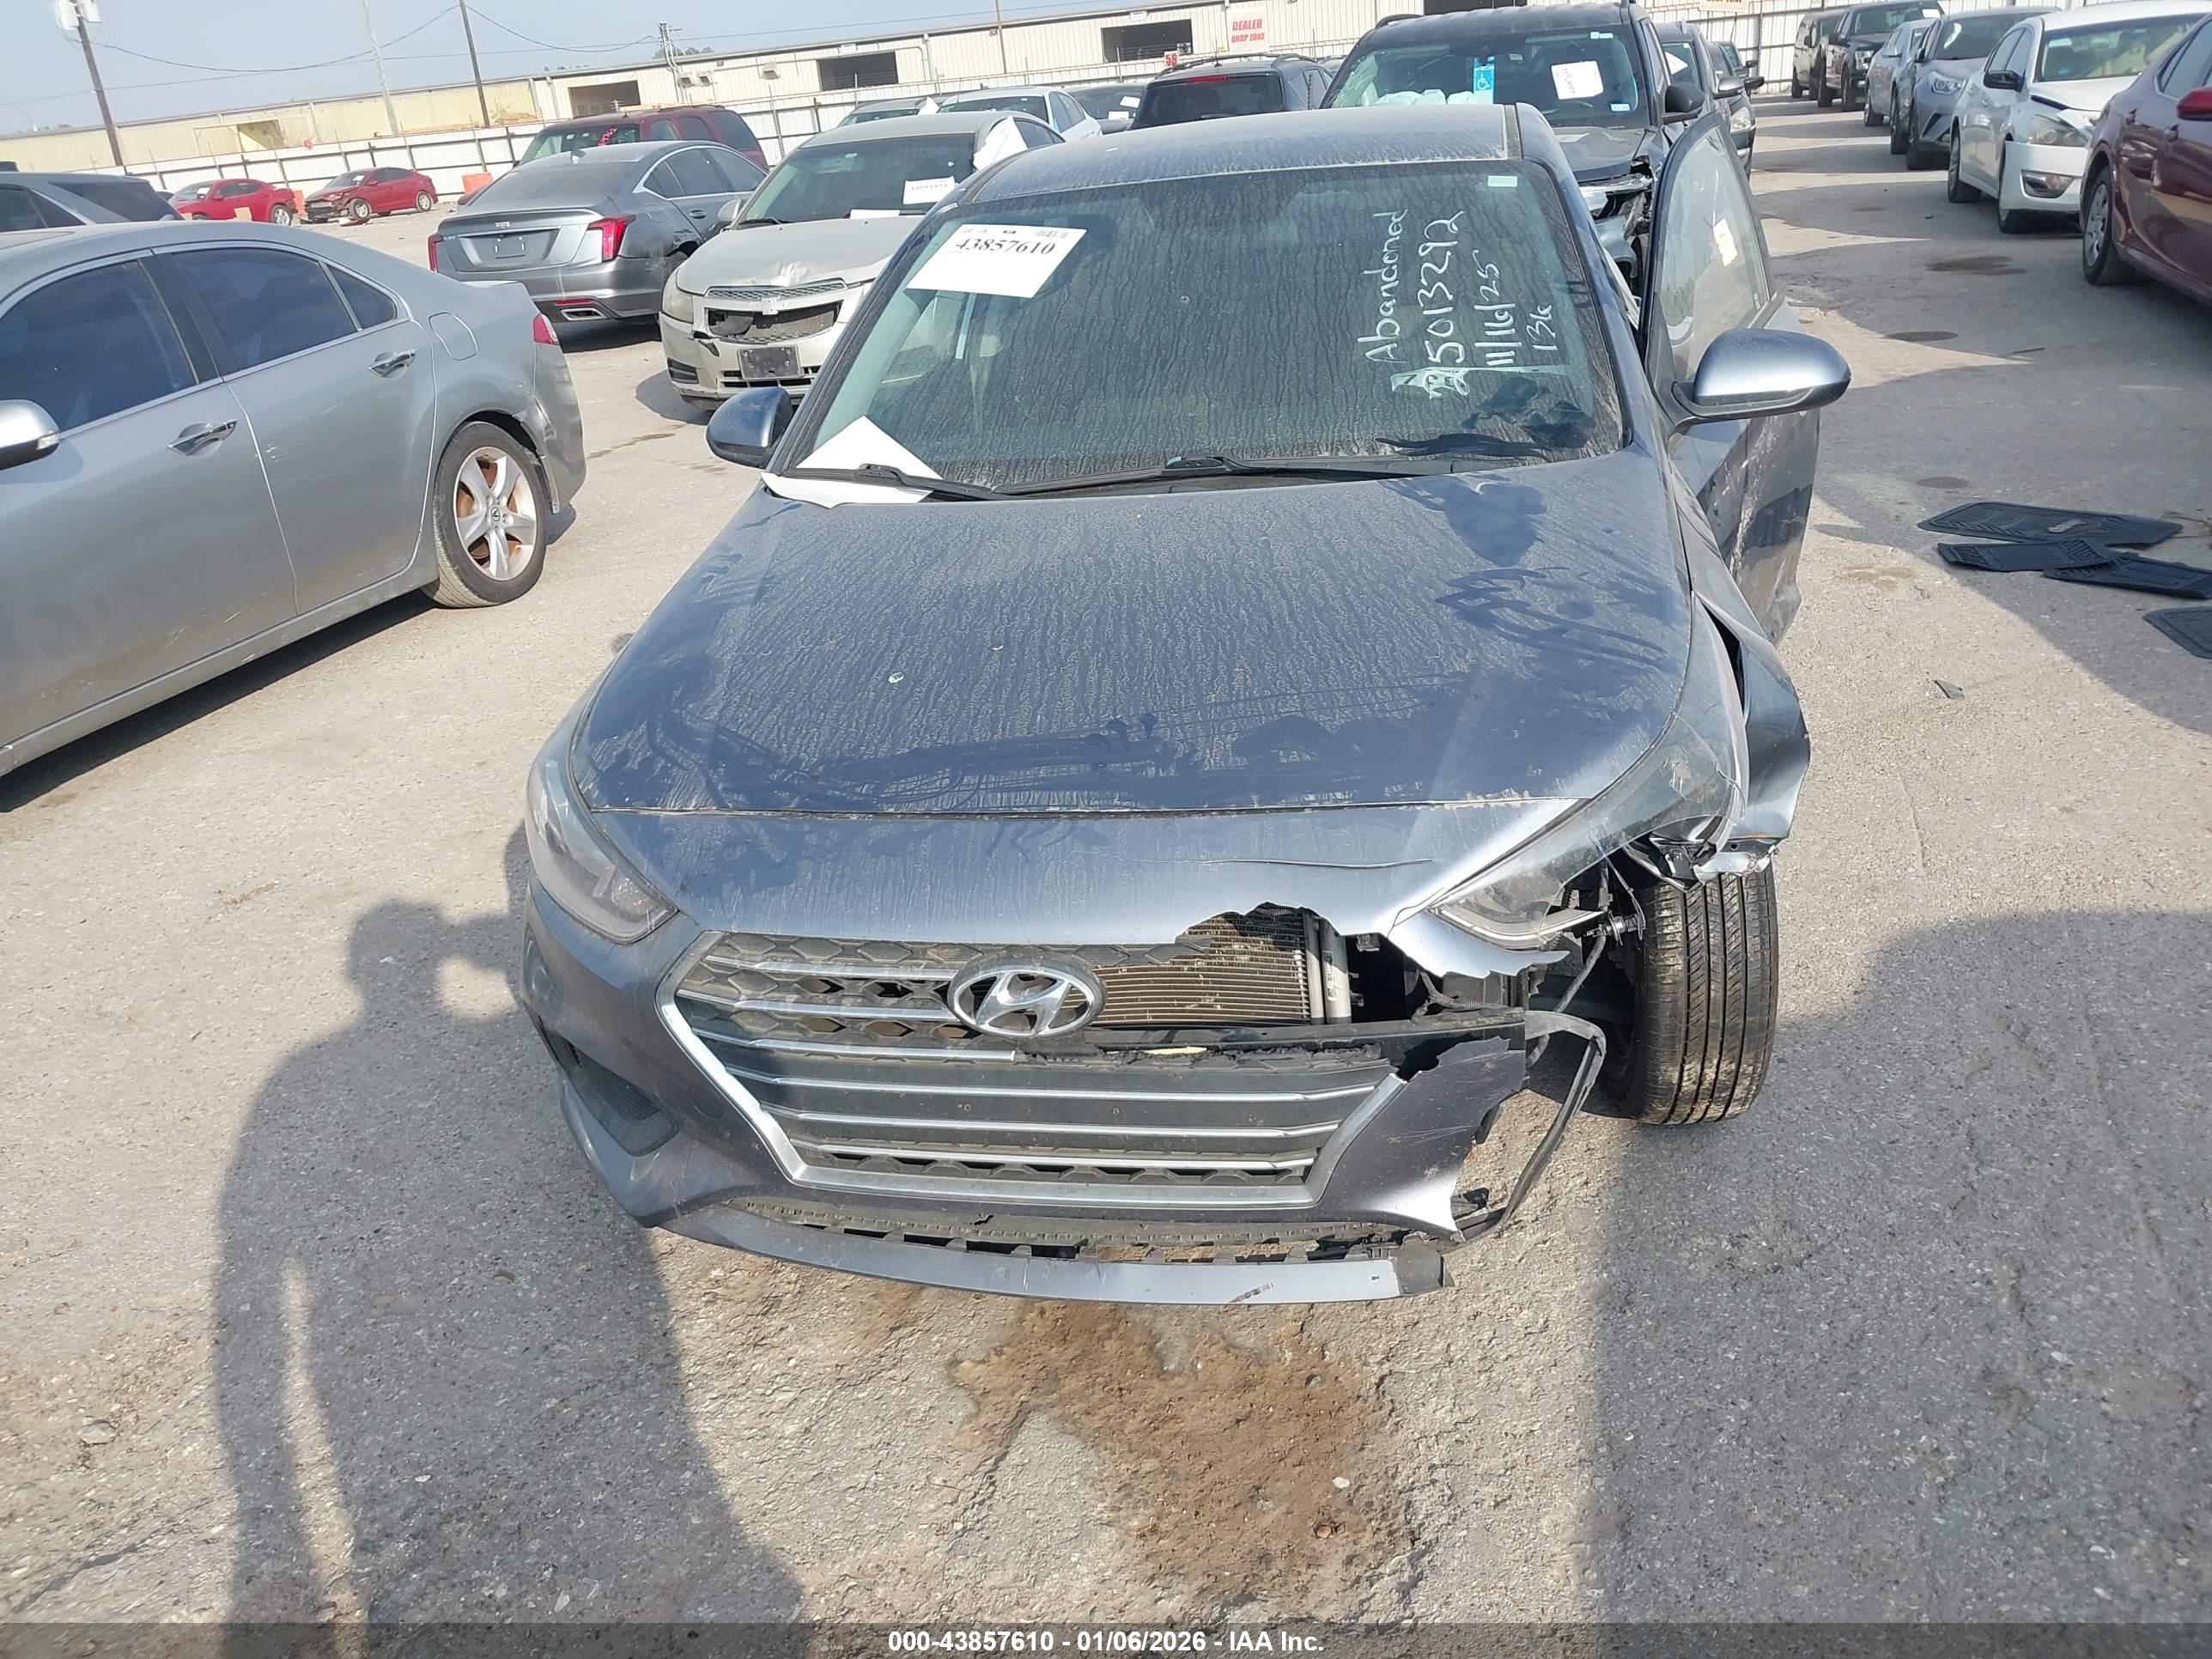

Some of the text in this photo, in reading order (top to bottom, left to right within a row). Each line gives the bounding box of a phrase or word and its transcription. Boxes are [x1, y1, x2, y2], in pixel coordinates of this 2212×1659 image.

[1232, 19, 1262, 31] DEALER
[1249, 33, 1264, 41] ZONE
[957, 238, 1056, 255] 43857610
[1358, 209, 1408, 363] Abandoned
